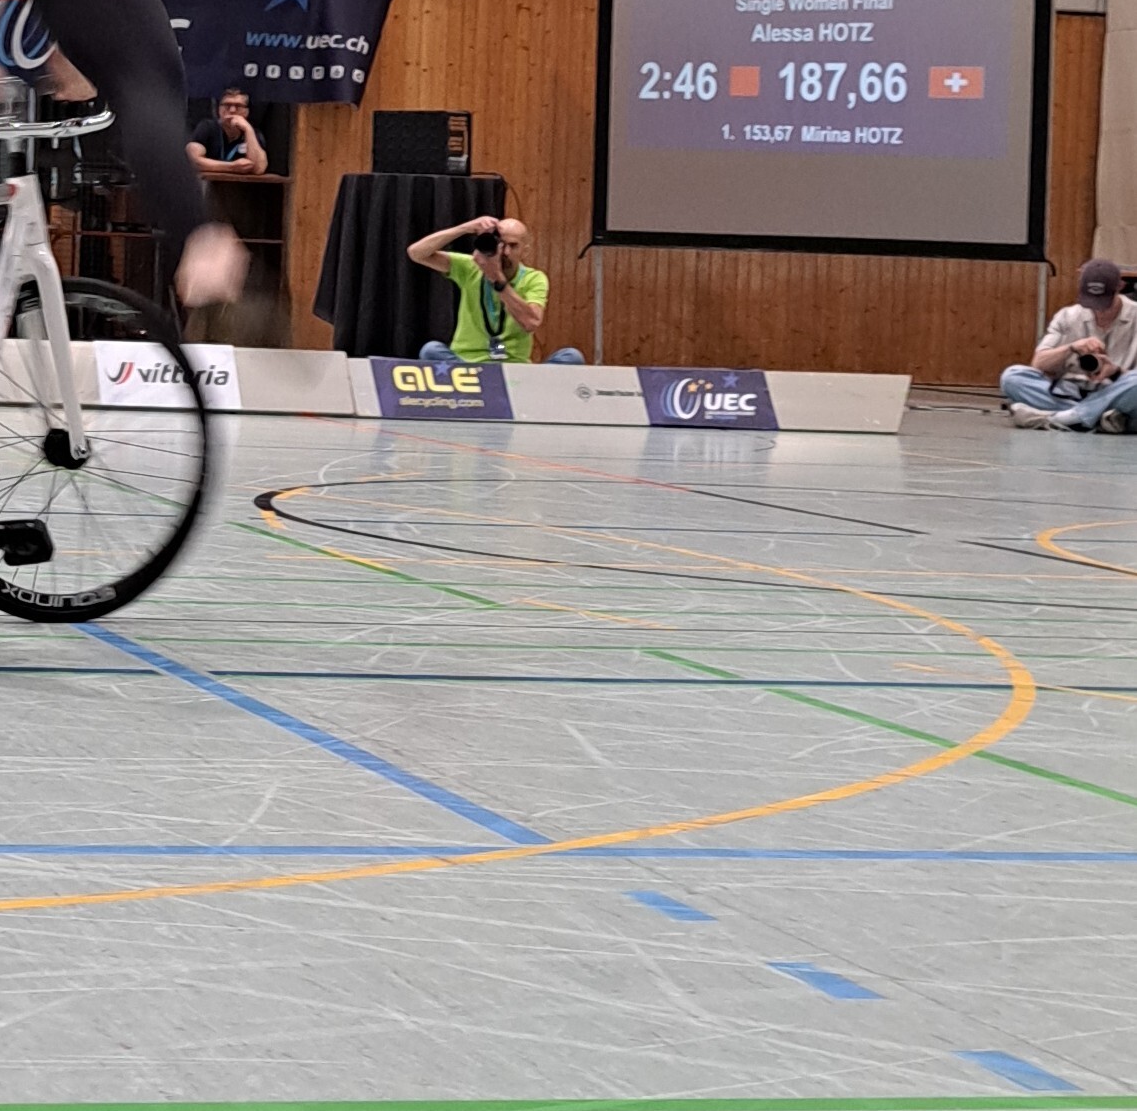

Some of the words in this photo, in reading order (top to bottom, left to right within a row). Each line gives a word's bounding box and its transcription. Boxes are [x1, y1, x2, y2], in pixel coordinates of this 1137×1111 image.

[751, 23, 814, 42] Alessa
[818, 22, 875, 42] HOTZ
[245, 31, 370, 55] www.uec.ch
[638, 61, 718, 102] 2:46
[778, 61, 908, 109] 187,66
[721, 124, 735, 140] 1.
[743, 124, 794, 144] 153,67
[801, 125, 851, 143] Mirina
[854, 127, 904, 144] HOTZ
[704, 392, 758, 411] UEC
